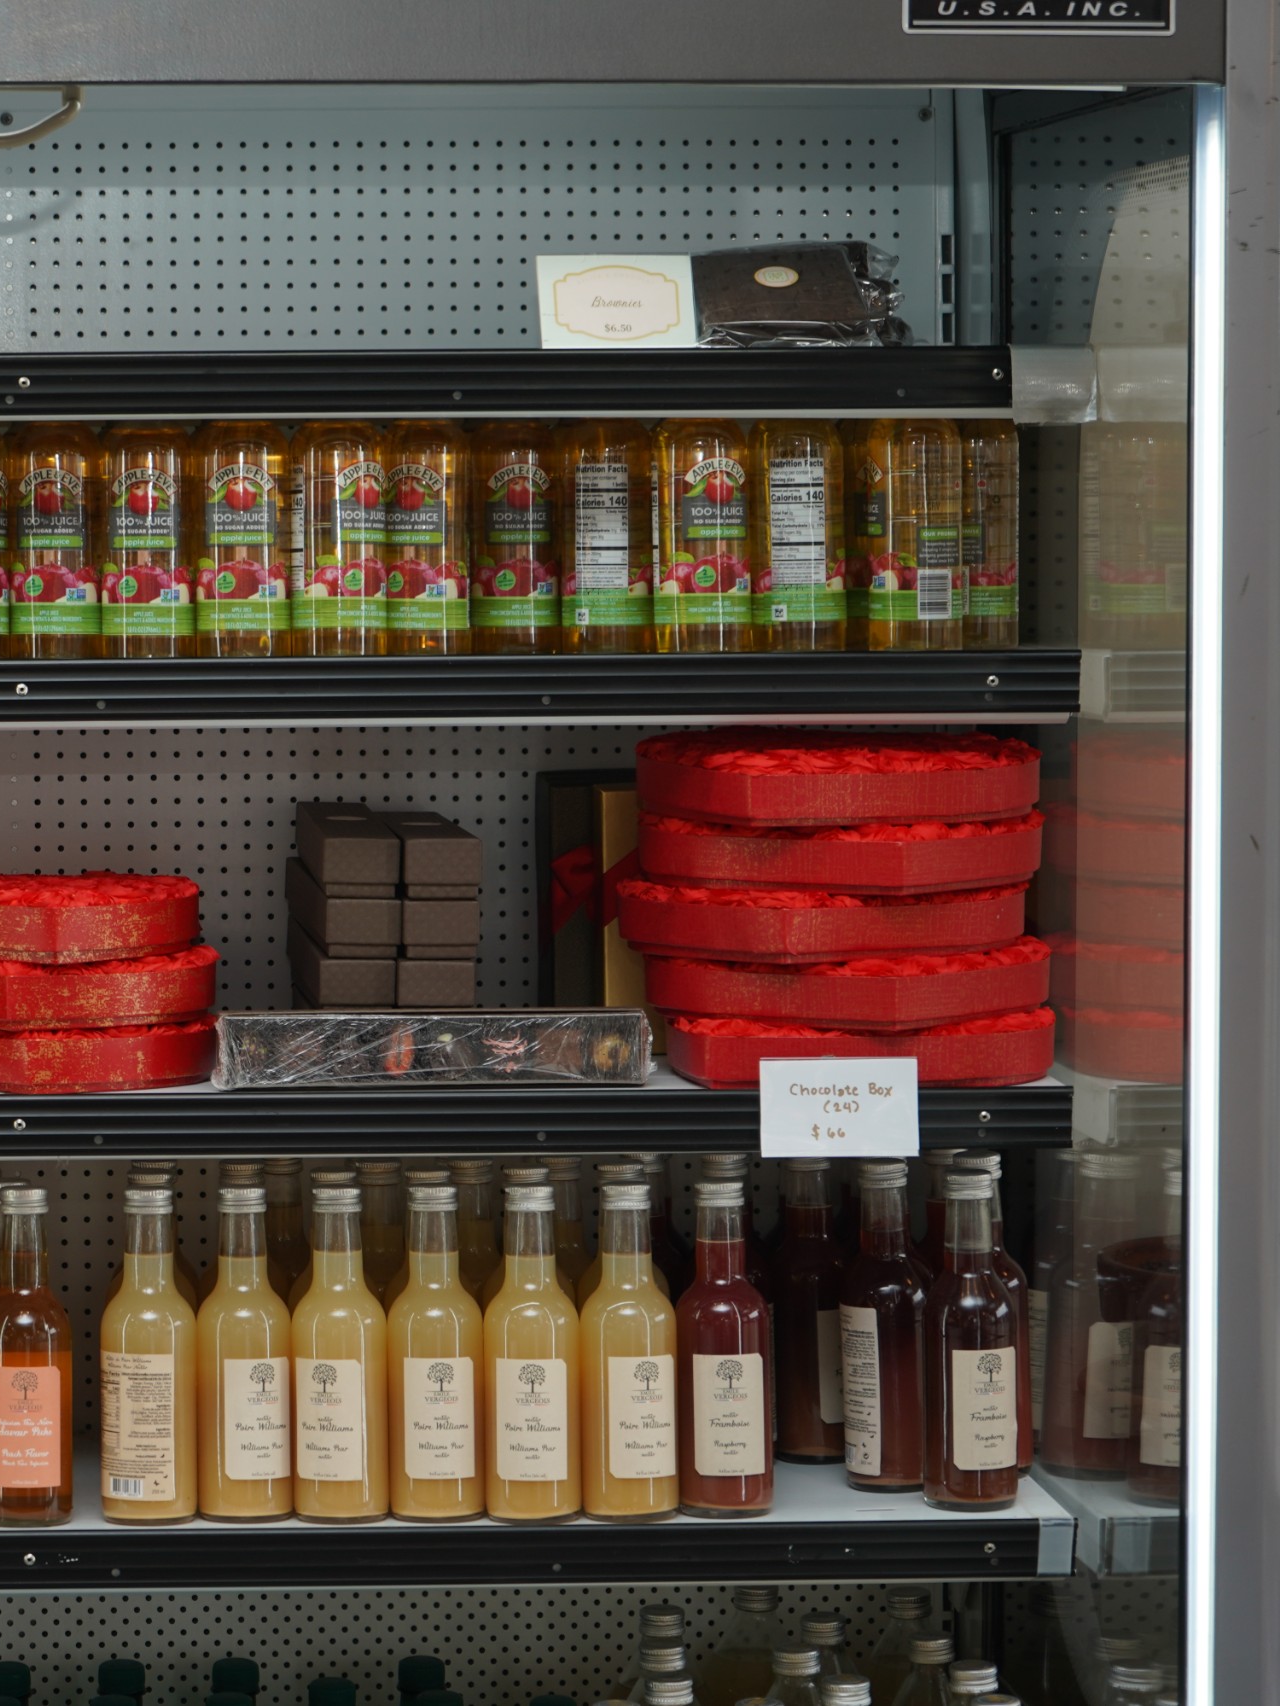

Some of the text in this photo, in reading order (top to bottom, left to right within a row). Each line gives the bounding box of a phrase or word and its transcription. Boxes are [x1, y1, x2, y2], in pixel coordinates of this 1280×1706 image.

[938, 1, 1140, 16] U.S.A. INC.
[591, 296, 642, 308] Brownies
[604, 324, 632, 333] $6.50
[576, 465, 627, 473] Nutrition Facts
[770, 460, 802, 468] Nutrition
[692, 459, 723, 482] APPLE
[23, 470, 79, 493] APPLE EVE
[118, 470, 147, 493] APPLE
[423, 469, 441, 488] EVE
[493, 466, 525, 489] APPLE
[576, 496, 628, 506] Calories 140
[771, 490, 824, 502] Calories 140
[493, 512, 546, 521] 100% JUICE
[691, 507, 743, 516] 100% JUICE
[50, 517, 79, 525] JUICE
[116, 517, 173, 526] 100% JUICE
[411, 513, 438, 521] JUICE
[789, 1082, 893, 1097] Chocolate Box
[823, 1100, 859, 1113] (24)
[970, 1412, 1007, 1422] Framboise
[319, 1422, 353, 1432] Williams
[436, 1420, 468, 1430] Williams
[526, 1423, 561, 1432] Williams
[709, 1419, 750, 1428] Framboise
